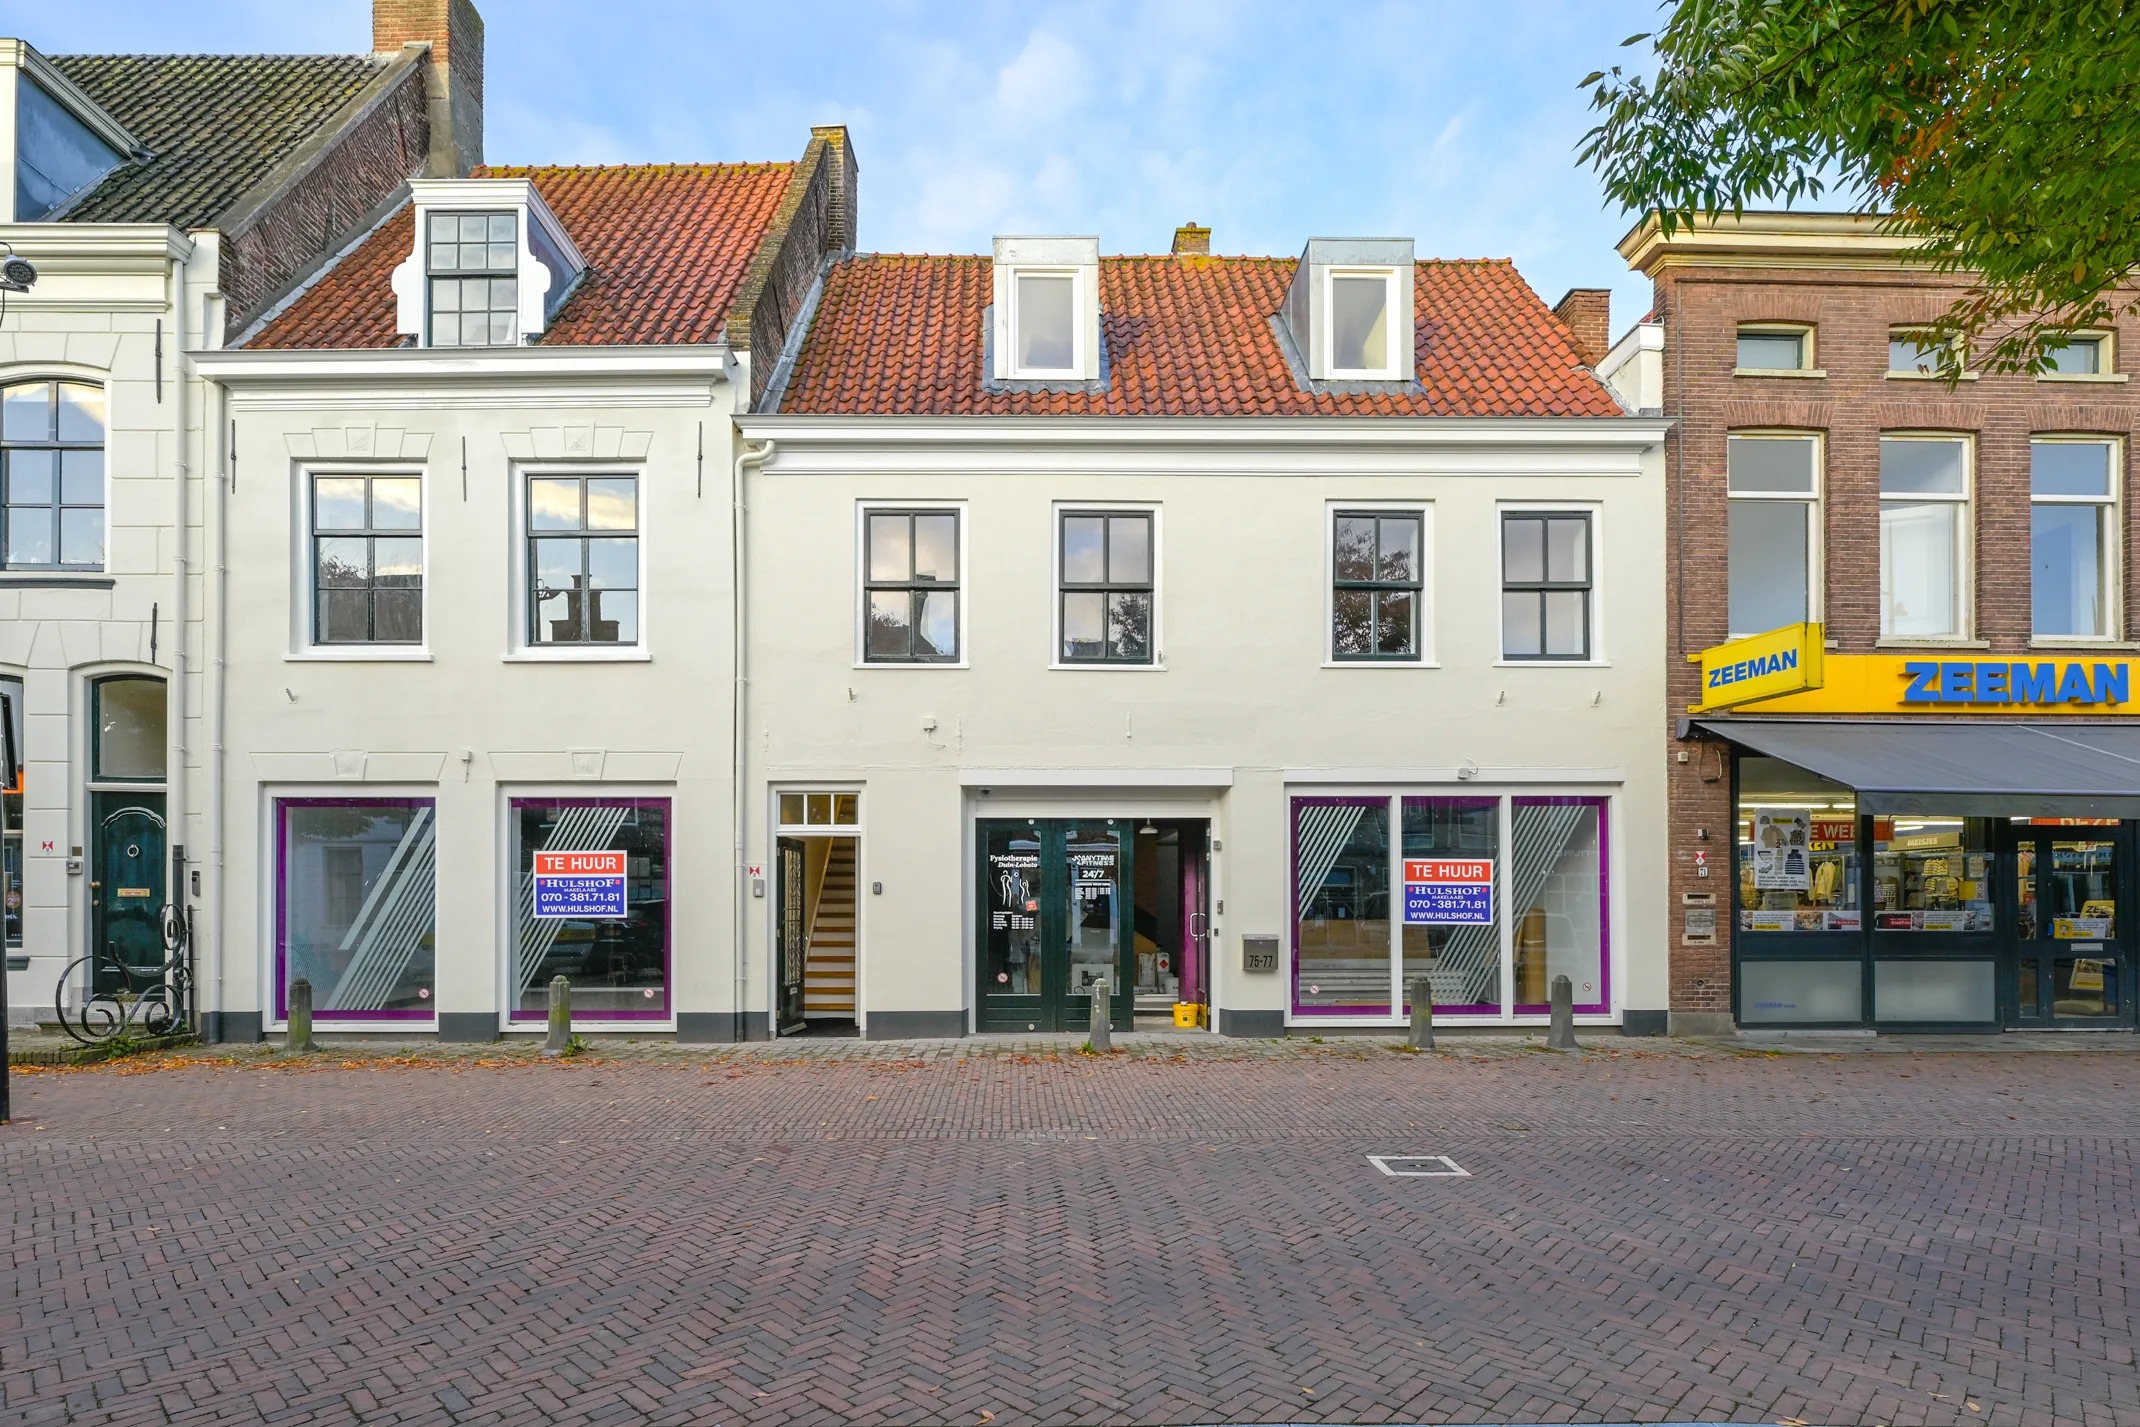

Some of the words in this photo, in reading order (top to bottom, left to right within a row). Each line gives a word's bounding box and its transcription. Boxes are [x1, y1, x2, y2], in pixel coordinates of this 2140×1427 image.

[1708, 648, 1798, 689] ZEEMAN
[1904, 661, 2129, 703] ZEEMAN
[1907, 837, 1938, 847] MEISJES
[544, 857, 564, 870] TE
[571, 857, 617, 870] HUUR
[1082, 869, 1105, 879] 24/7
[1413, 865, 1433, 877] TE
[1439, 865, 1483, 878] HUUR
[546, 879, 615, 888] HULSHOF
[1415, 887, 1481, 896] HULSHOF
[542, 905, 619, 913] WWW.HULSHOF.NL
[1410, 912, 1485, 920] WWW.HULSHOF.NL
[1249, 955, 1273, 968] 75-77
